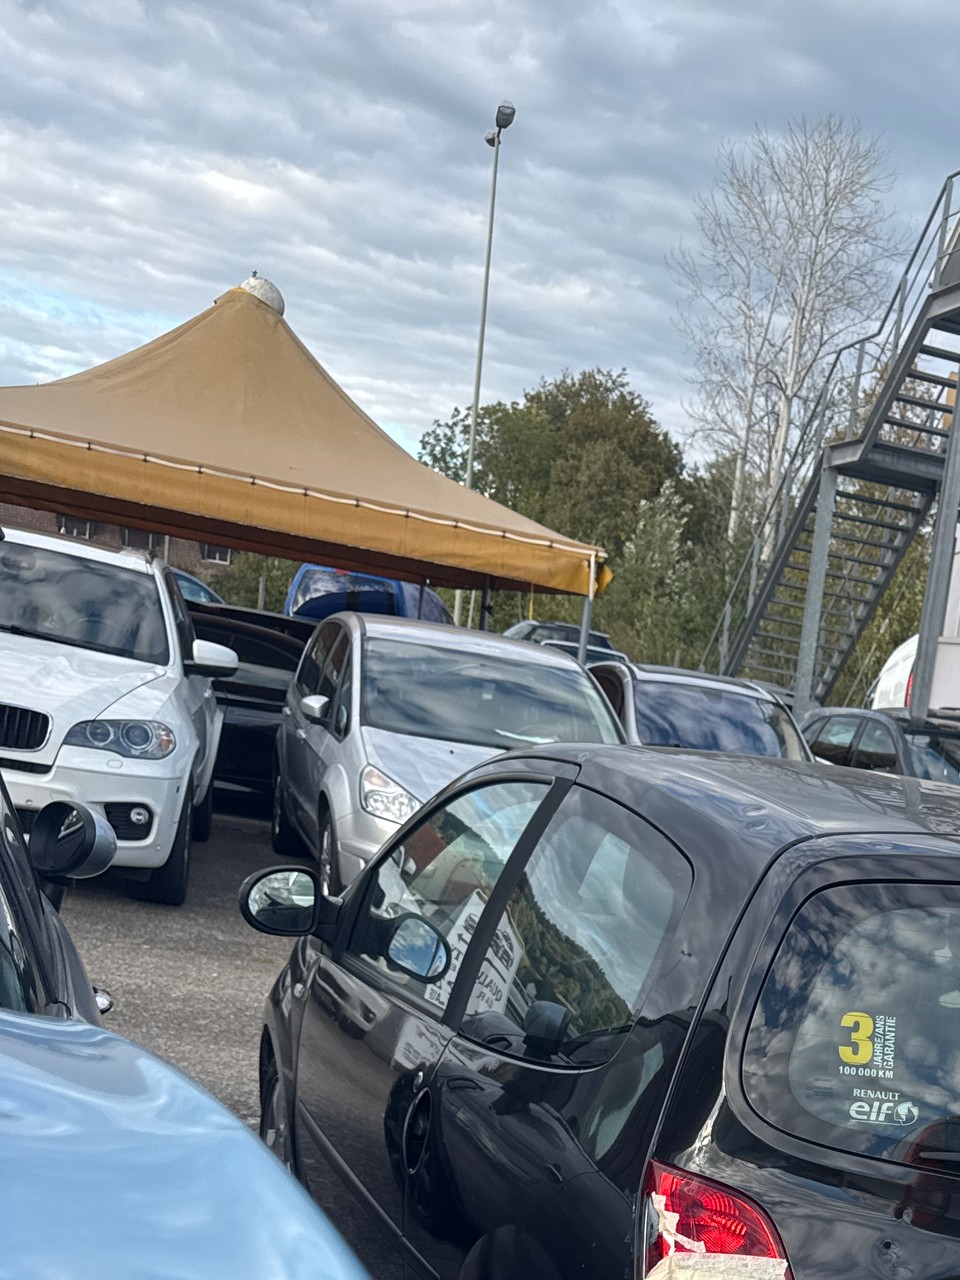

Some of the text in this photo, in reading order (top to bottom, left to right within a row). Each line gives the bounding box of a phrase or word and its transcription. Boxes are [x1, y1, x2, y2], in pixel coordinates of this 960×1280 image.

[838, 1011, 874, 1066] 3
[873, 1014, 886, 1068] JAHRE/ANS
[883, 1016, 897, 1069] GARANTIE
[838, 1066, 857, 1076] 100
[878, 1070, 894, 1079] KM
[849, 1101, 895, 1121] elf
[853, 1088, 901, 1101] RENAULT
